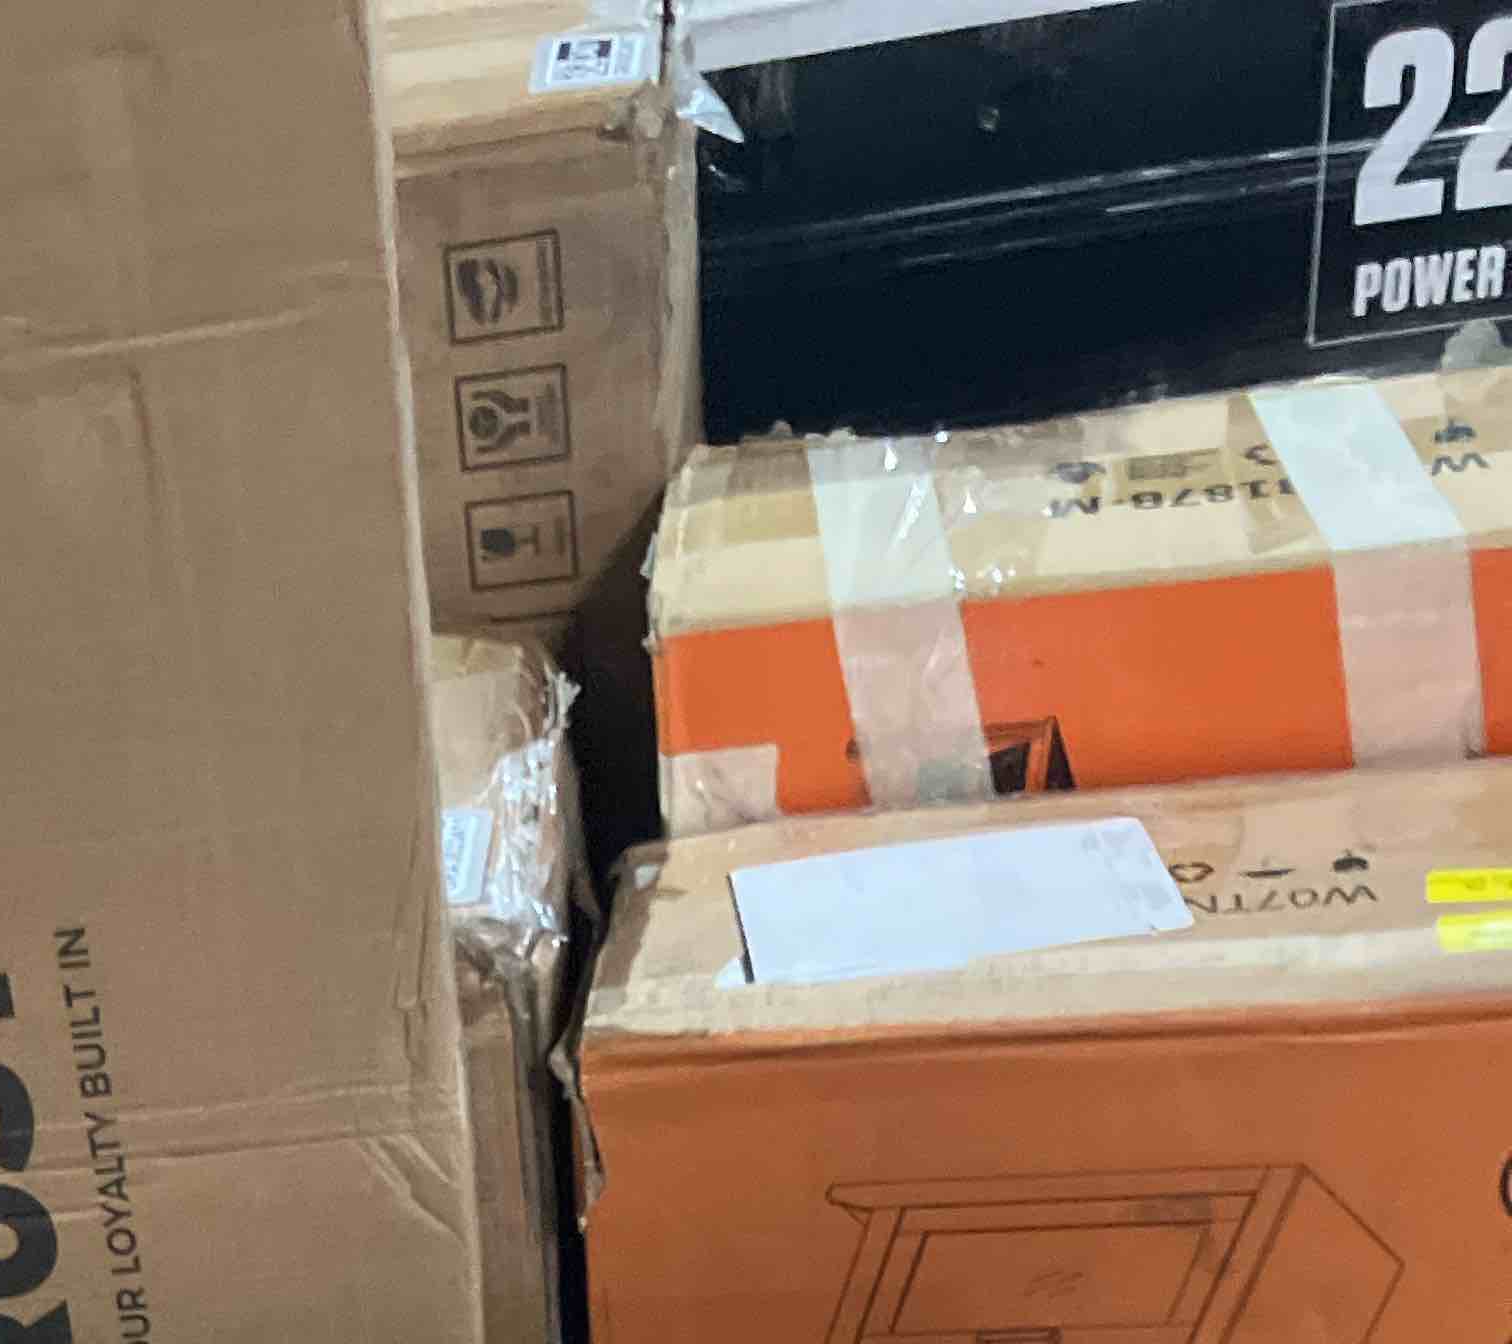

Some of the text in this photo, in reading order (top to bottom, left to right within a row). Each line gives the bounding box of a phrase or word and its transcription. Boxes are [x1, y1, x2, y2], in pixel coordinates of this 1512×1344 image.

[1352, 244, 1506, 318] POWER
[54, 926, 87, 969] IN
[62, 983, 114, 1098] BUILT
[88, 1111, 142, 1275] LOYALTY
